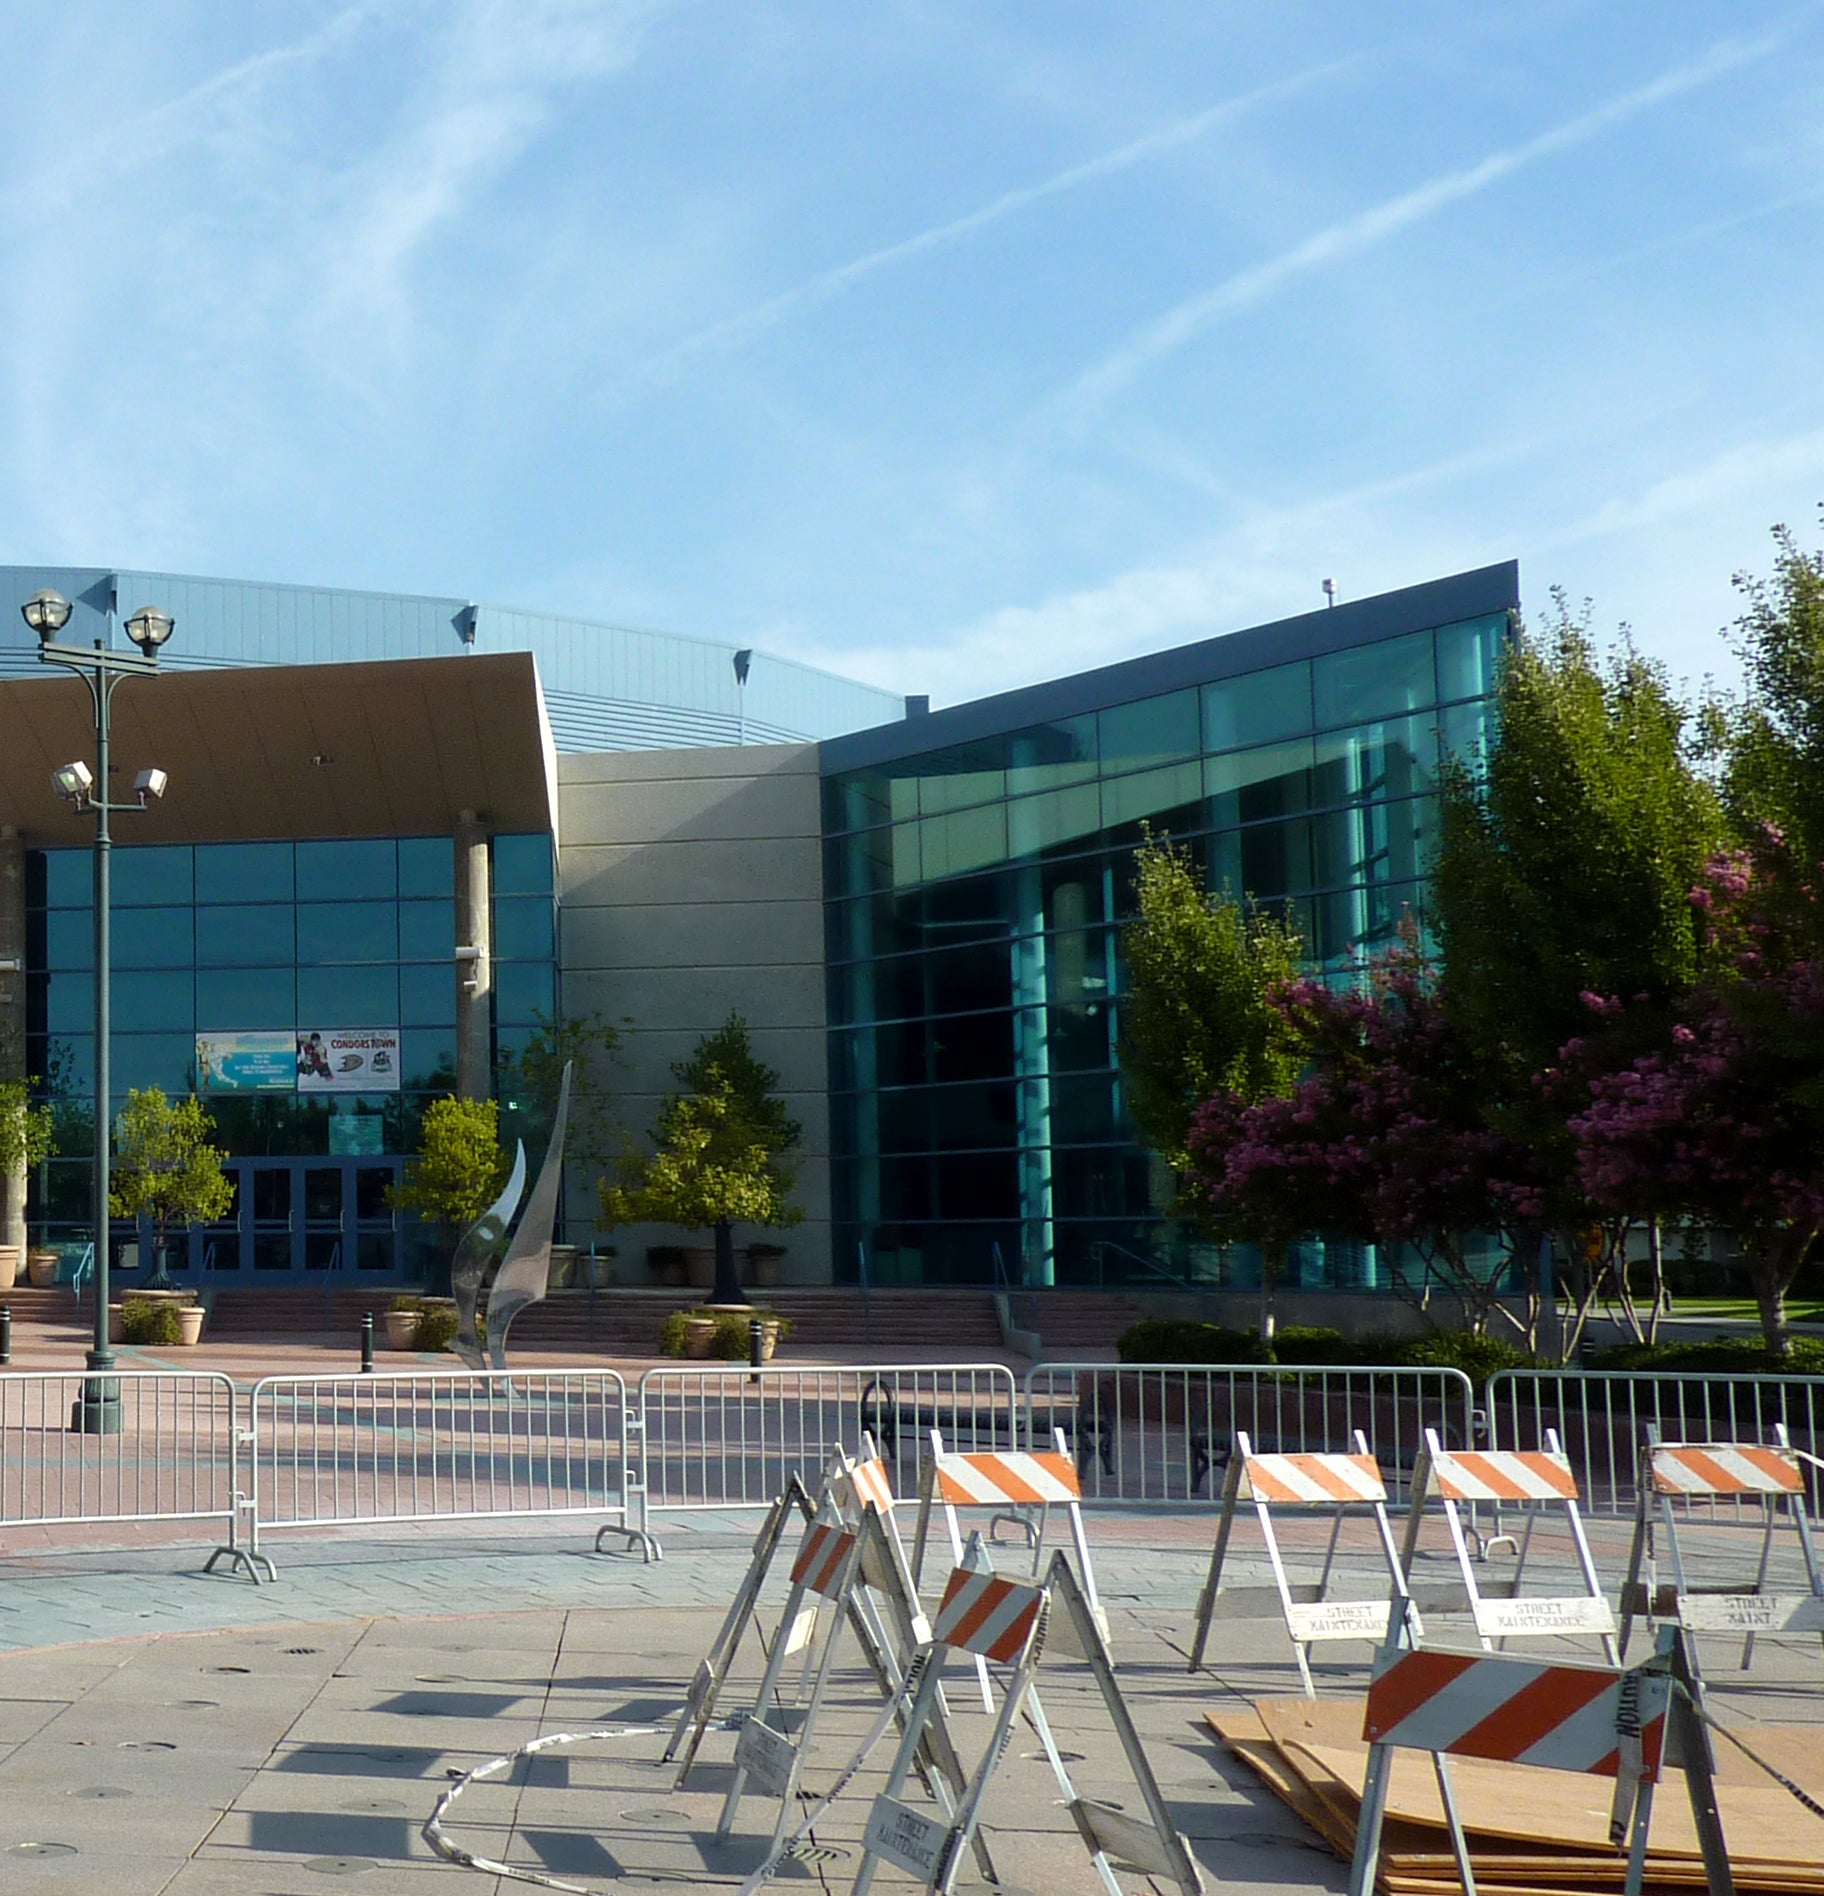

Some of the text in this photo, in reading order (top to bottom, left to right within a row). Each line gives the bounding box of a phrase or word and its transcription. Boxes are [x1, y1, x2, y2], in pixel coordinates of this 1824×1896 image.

[1326, 1606, 1372, 1618] STREET
[1516, 1603, 1563, 1615] STREET
[1309, 1619, 1389, 1632] MAINTENANC
[1616, 1675, 1640, 1739] AUTION
